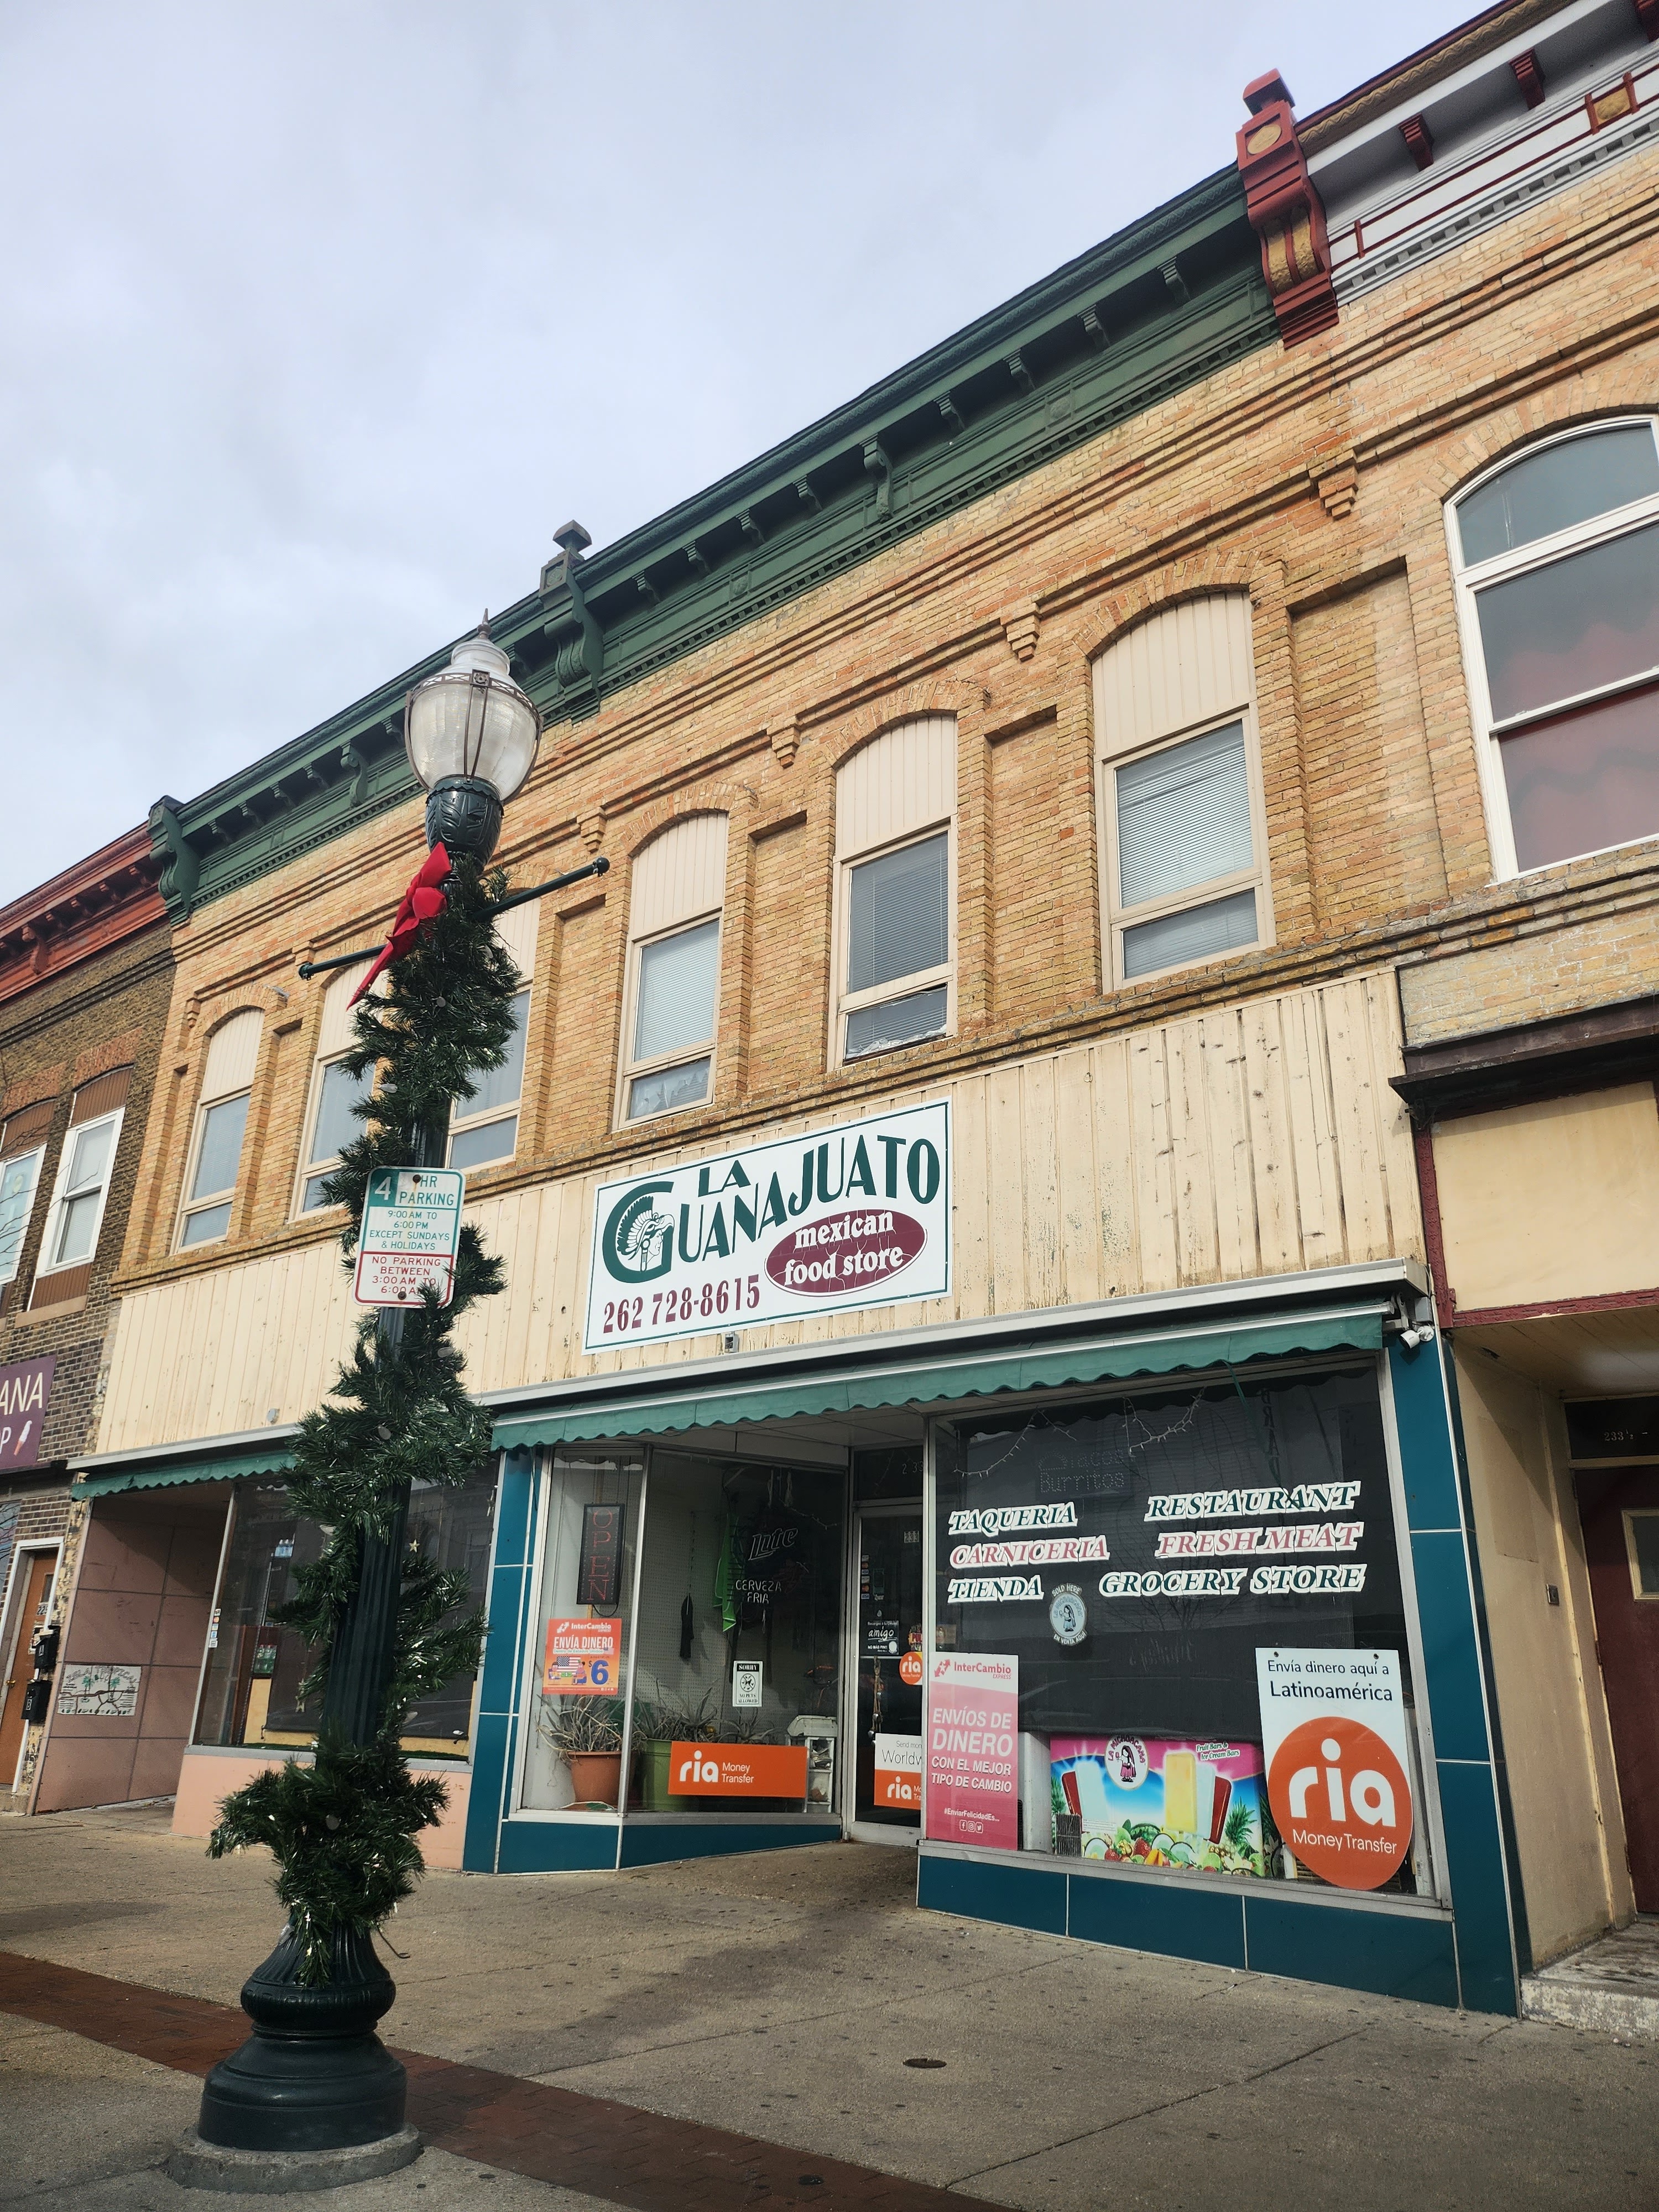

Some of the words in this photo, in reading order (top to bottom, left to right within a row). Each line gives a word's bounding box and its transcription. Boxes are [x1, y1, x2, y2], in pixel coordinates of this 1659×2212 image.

[374, 1176, 391, 1200] 4
[420, 1176, 437, 1188] HR
[698, 1160, 750, 1197] LA
[399, 1192, 455, 1206] PARKING
[602, 1135, 940, 1284] GUANAJUATO
[370, 1230, 403, 1239] EXCEPT
[407, 1232, 450, 1240] SUNDAYS
[794, 1211, 894, 1249] mexican
[391, 1241, 435, 1250] HOLIDAYS
[380, 1266, 430, 1276] BETWEEN
[393, 1257, 441, 1266] PARKING
[784, 1255, 837, 1286] food
[842, 1245, 903, 1274] store
[372, 1276, 397, 1284] 3:00
[399, 1276, 416, 1285] AM
[423, 1277, 436, 1286] TO
[603, 1296, 644, 1334] 262
[652, 1274, 760, 1326] 728-8615
[1041, 1471, 1124, 1493] Burritos
[1144, 1480, 1361, 1521] RESTAURANT
[948, 1501, 1078, 1536] TAQUERIA
[1155, 1530, 1262, 1558] FRESH
[1262, 1522, 1364, 1553] MEAT
[587, 1509, 613, 1601] OPEN
[950, 1535, 1110, 1569] CARNICERIA
[736, 1579, 781, 1592] CERVEZA
[947, 1575, 1045, 1603] TIENDA
[1052, 1584, 1065, 1597] SOLD
[1066, 1584, 1081, 1594] HERE
[1099, 1568, 1248, 1597] GROCERY
[1250, 1564, 1368, 1594] STORE
[748, 1592, 769, 1604] FRIA
[554, 1635, 579, 1648] ENVÍA
[582, 1636, 613, 1648] DINERO
[868, 1626, 894, 1640] amigo
[902, 1656, 921, 1673] ria
[954, 1661, 1011, 1674] InterCambio
[1267, 1660, 1301, 1673] Envía
[1306, 1661, 1345, 1674] dinero
[1350, 1661, 1378, 1677] aquí
[1382, 1666, 1389, 1674] a
[1270, 1681, 1392, 1701] Latinoamérica
[932, 1706, 987, 1726] ENVÍOS
[990, 1712, 1012, 1729] DE
[932, 1728, 1013, 1757] DINERO
[1196, 1743, 1209, 1752] Fruit
[680, 1750, 719, 1782] ria
[932, 1756, 954, 1769] CON
[957, 1759, 969, 1771] EL
[973, 1760, 1011, 1776] MEJOR
[1108, 1751, 1114, 1761] LA
[722, 1762, 750, 1773] Money
[722, 1773, 754, 1783] Transfer
[888, 1776, 912, 1799] ria
[931, 1772, 953, 1785] TIPO
[955, 1776, 969, 1787] DE
[972, 1777, 1012, 1793] CAMBIO
[1288, 1738, 1396, 1828] ria
[1293, 1829, 1343, 1851] Money
[1344, 1833, 1397, 1854] Transfer
